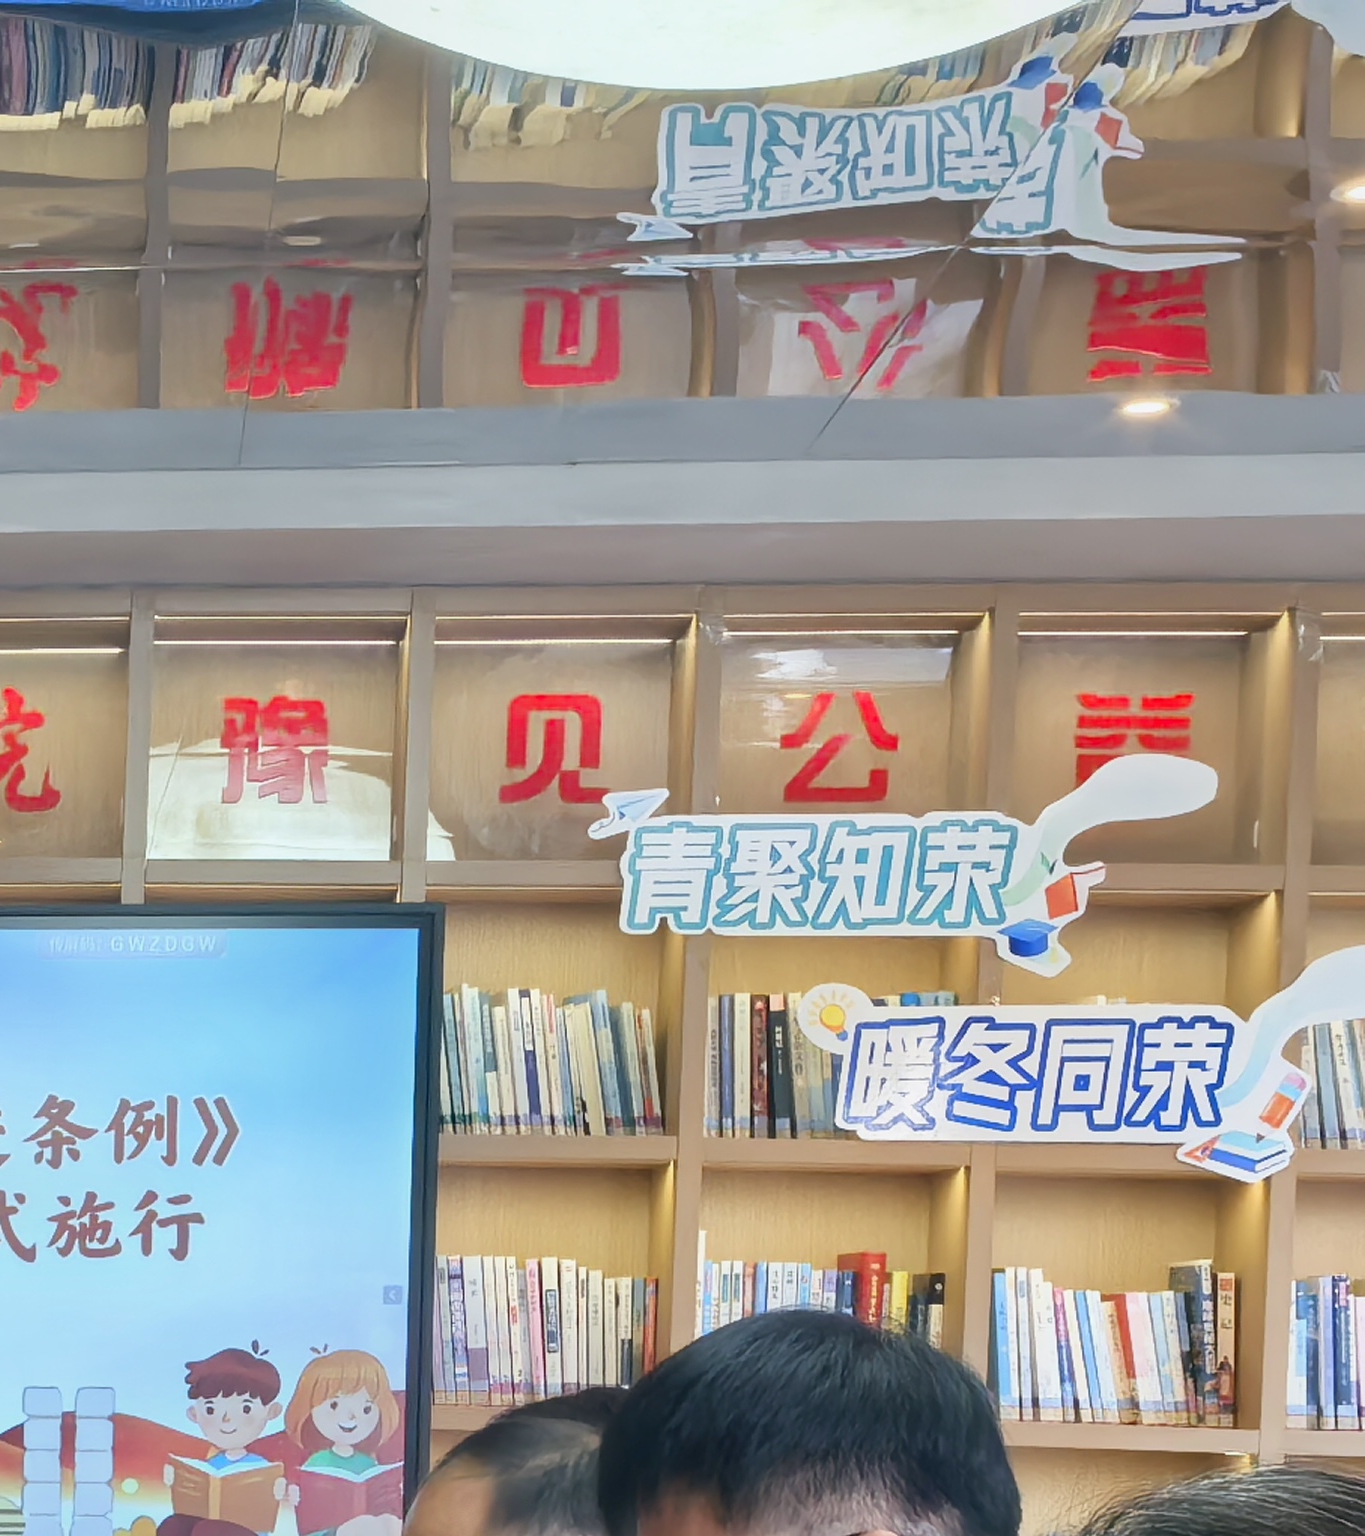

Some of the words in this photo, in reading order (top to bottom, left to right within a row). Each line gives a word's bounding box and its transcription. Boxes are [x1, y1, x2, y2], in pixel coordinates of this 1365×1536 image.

[626, 819, 1018, 931] 青聚知荥
[842, 1015, 1235, 1136] 暖冬同荥
